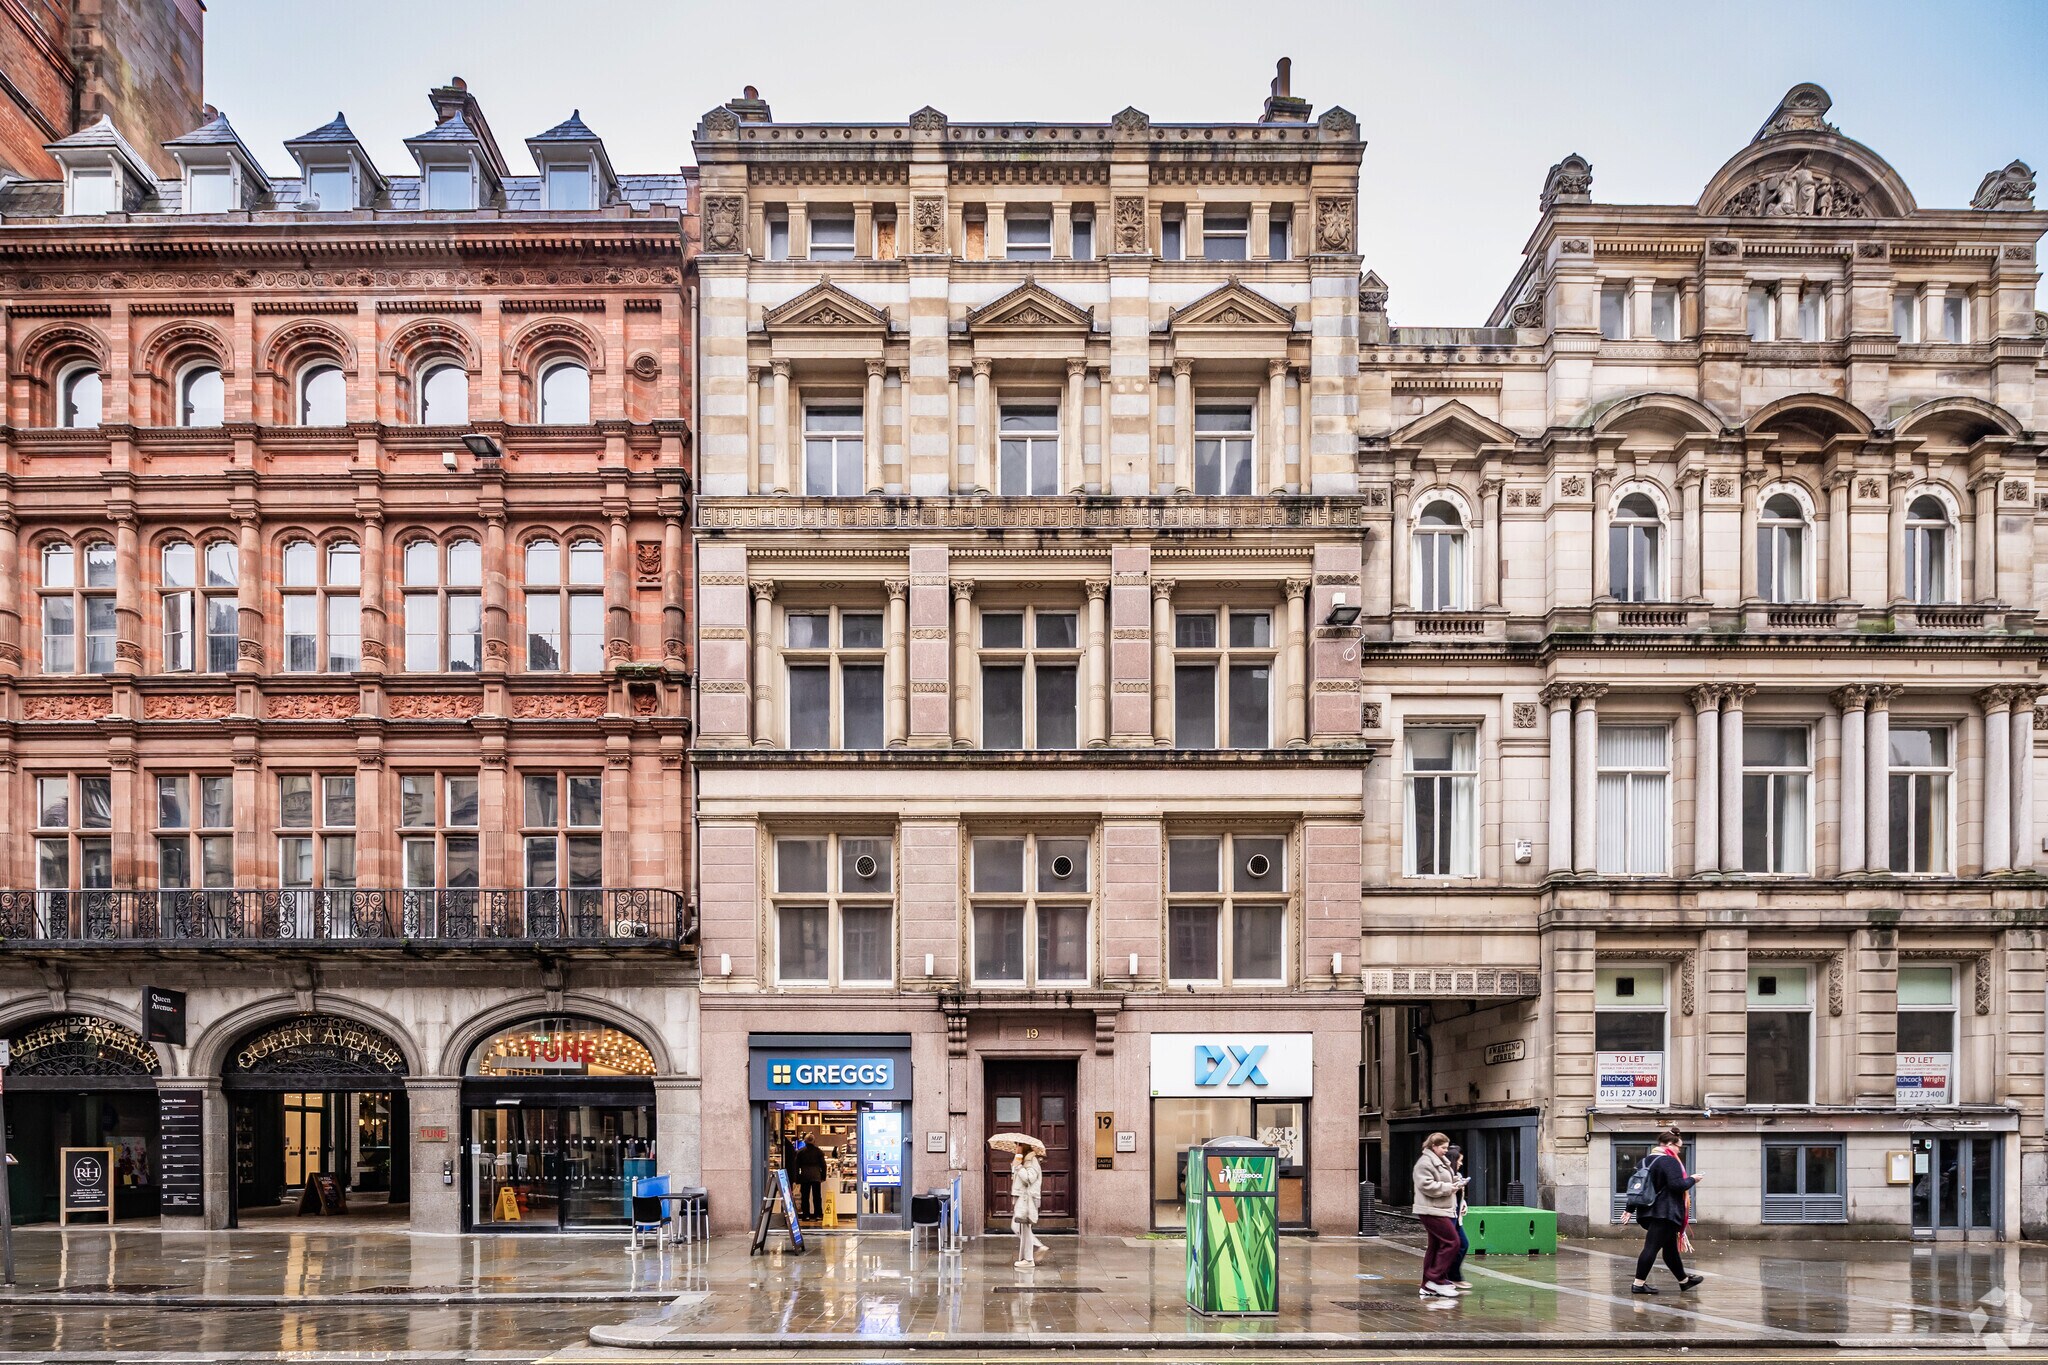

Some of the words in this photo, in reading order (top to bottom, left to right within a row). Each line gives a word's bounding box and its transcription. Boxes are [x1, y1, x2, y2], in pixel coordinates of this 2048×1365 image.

[152, 993, 171, 1003] Queen
[1026, 1029, 1039, 1039] 19
[9, 1028, 66, 1057] UEEN
[84, 1028, 158, 1073] AVENUE
[238, 1028, 312, 1068] QUEEN
[322, 1027, 401, 1072] AVENUE
[525, 1040, 596, 1063] TUNE
[1489, 1043, 1520, 1054] SWEETING
[1493, 1052, 1516, 1062] STREET
[1904, 1056, 1916, 1064] TO
[1918, 1056, 1934, 1064] LET
[1195, 1045, 1269, 1086] DX
[796, 1065, 888, 1084] GREGGS
[1634, 1075, 1657, 1083] Wright
[1923, 1076, 1945, 1084] Wright
[1097, 1116, 1112, 1129] 19
[421, 1129, 447, 1138] TUNE
